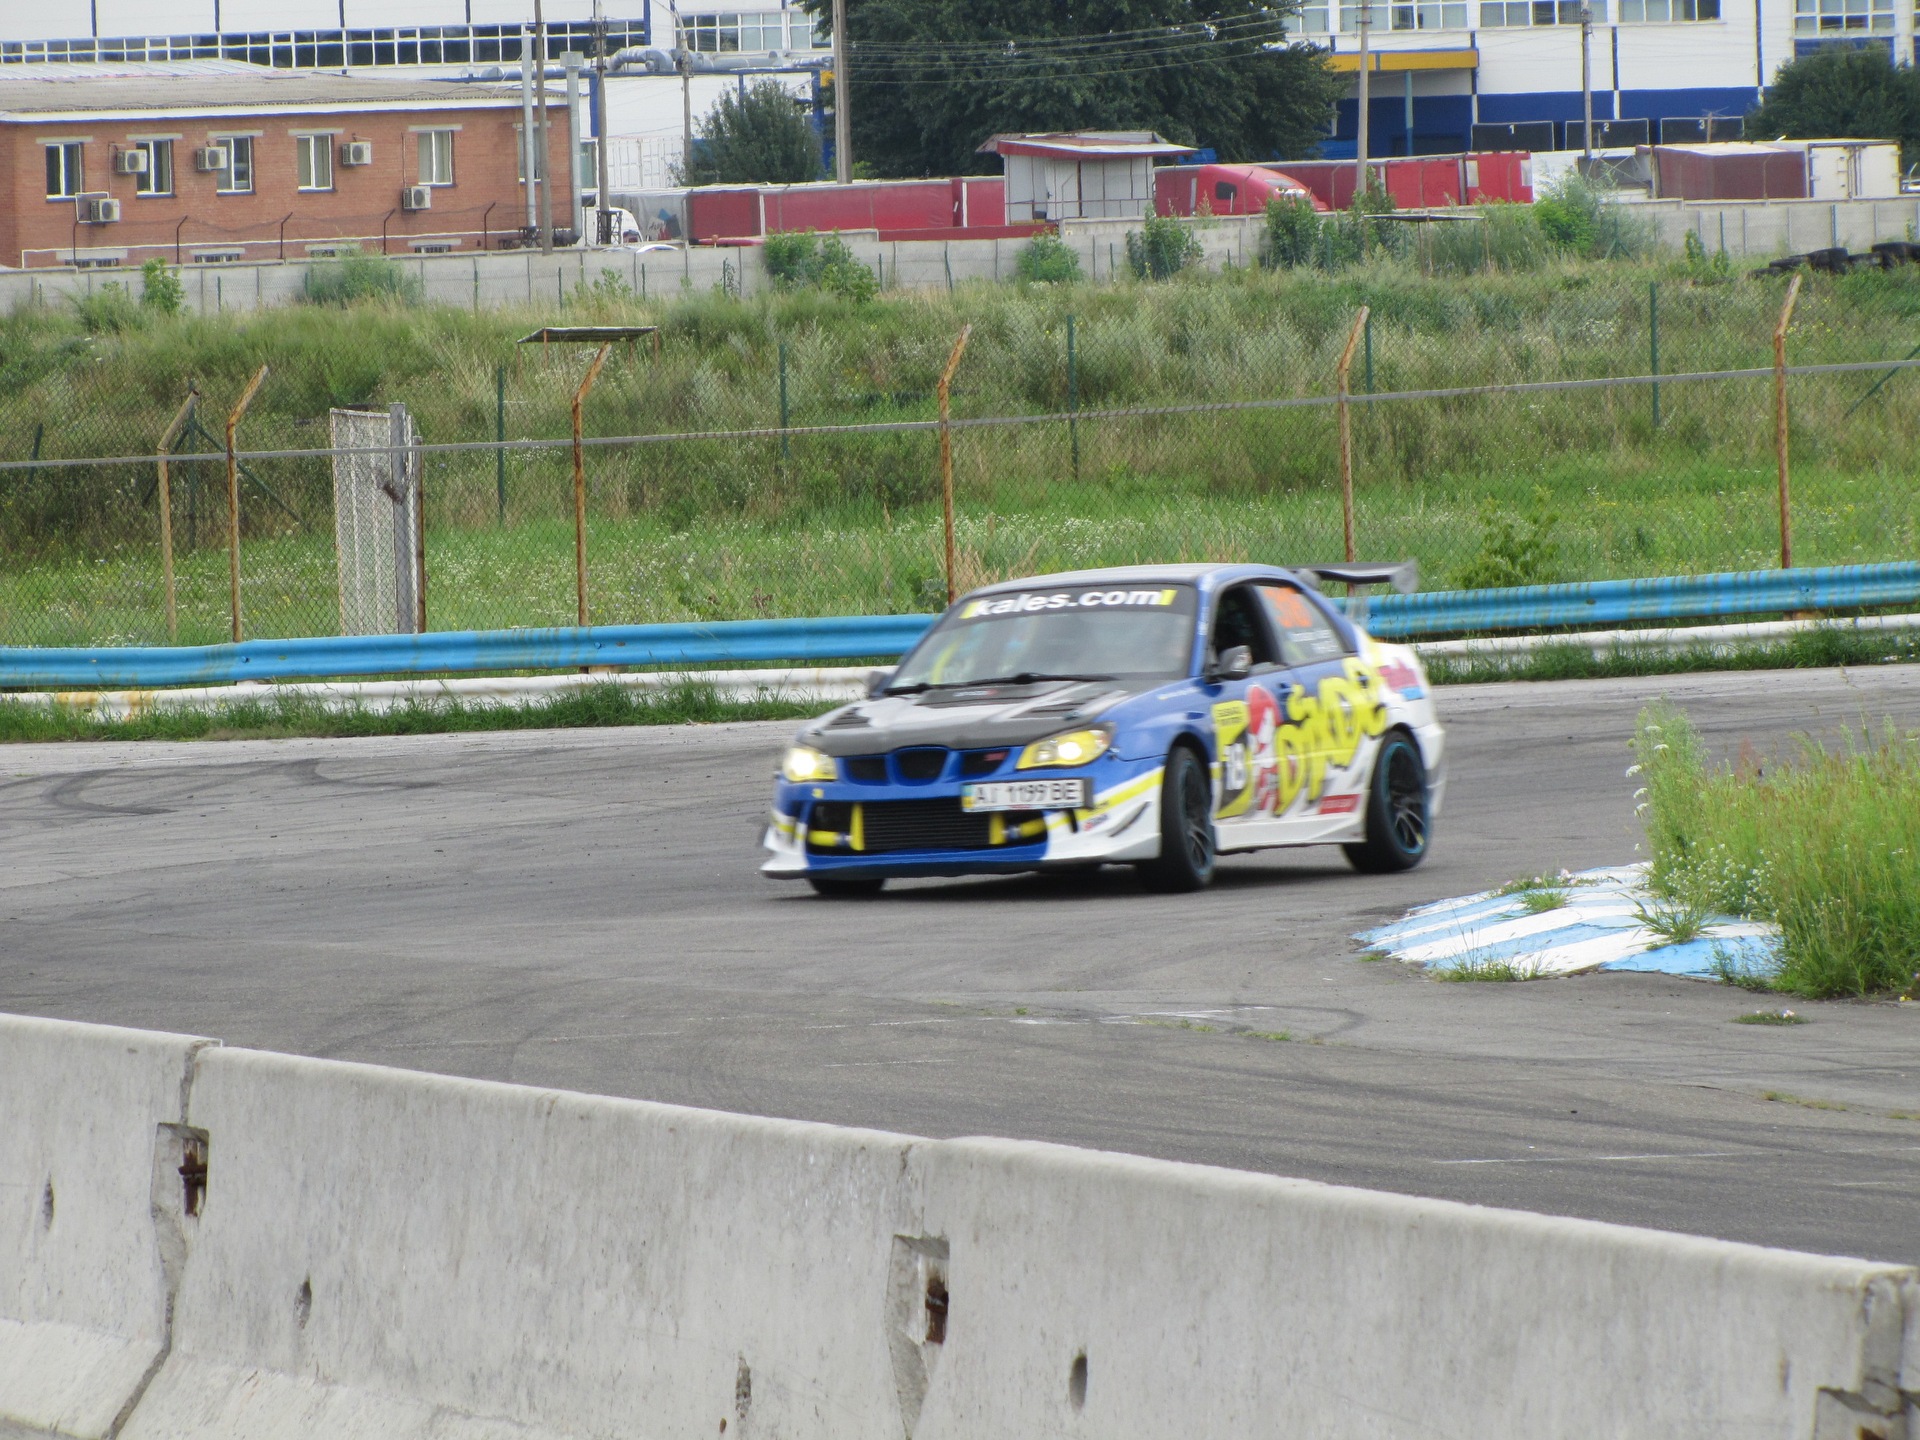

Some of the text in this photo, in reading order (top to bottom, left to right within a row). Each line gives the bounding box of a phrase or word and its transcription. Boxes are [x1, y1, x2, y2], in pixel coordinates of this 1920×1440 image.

[1508, 125, 1515, 135] 1
[1603, 122, 1610, 132] 2
[1698, 120, 1706, 130] 3
